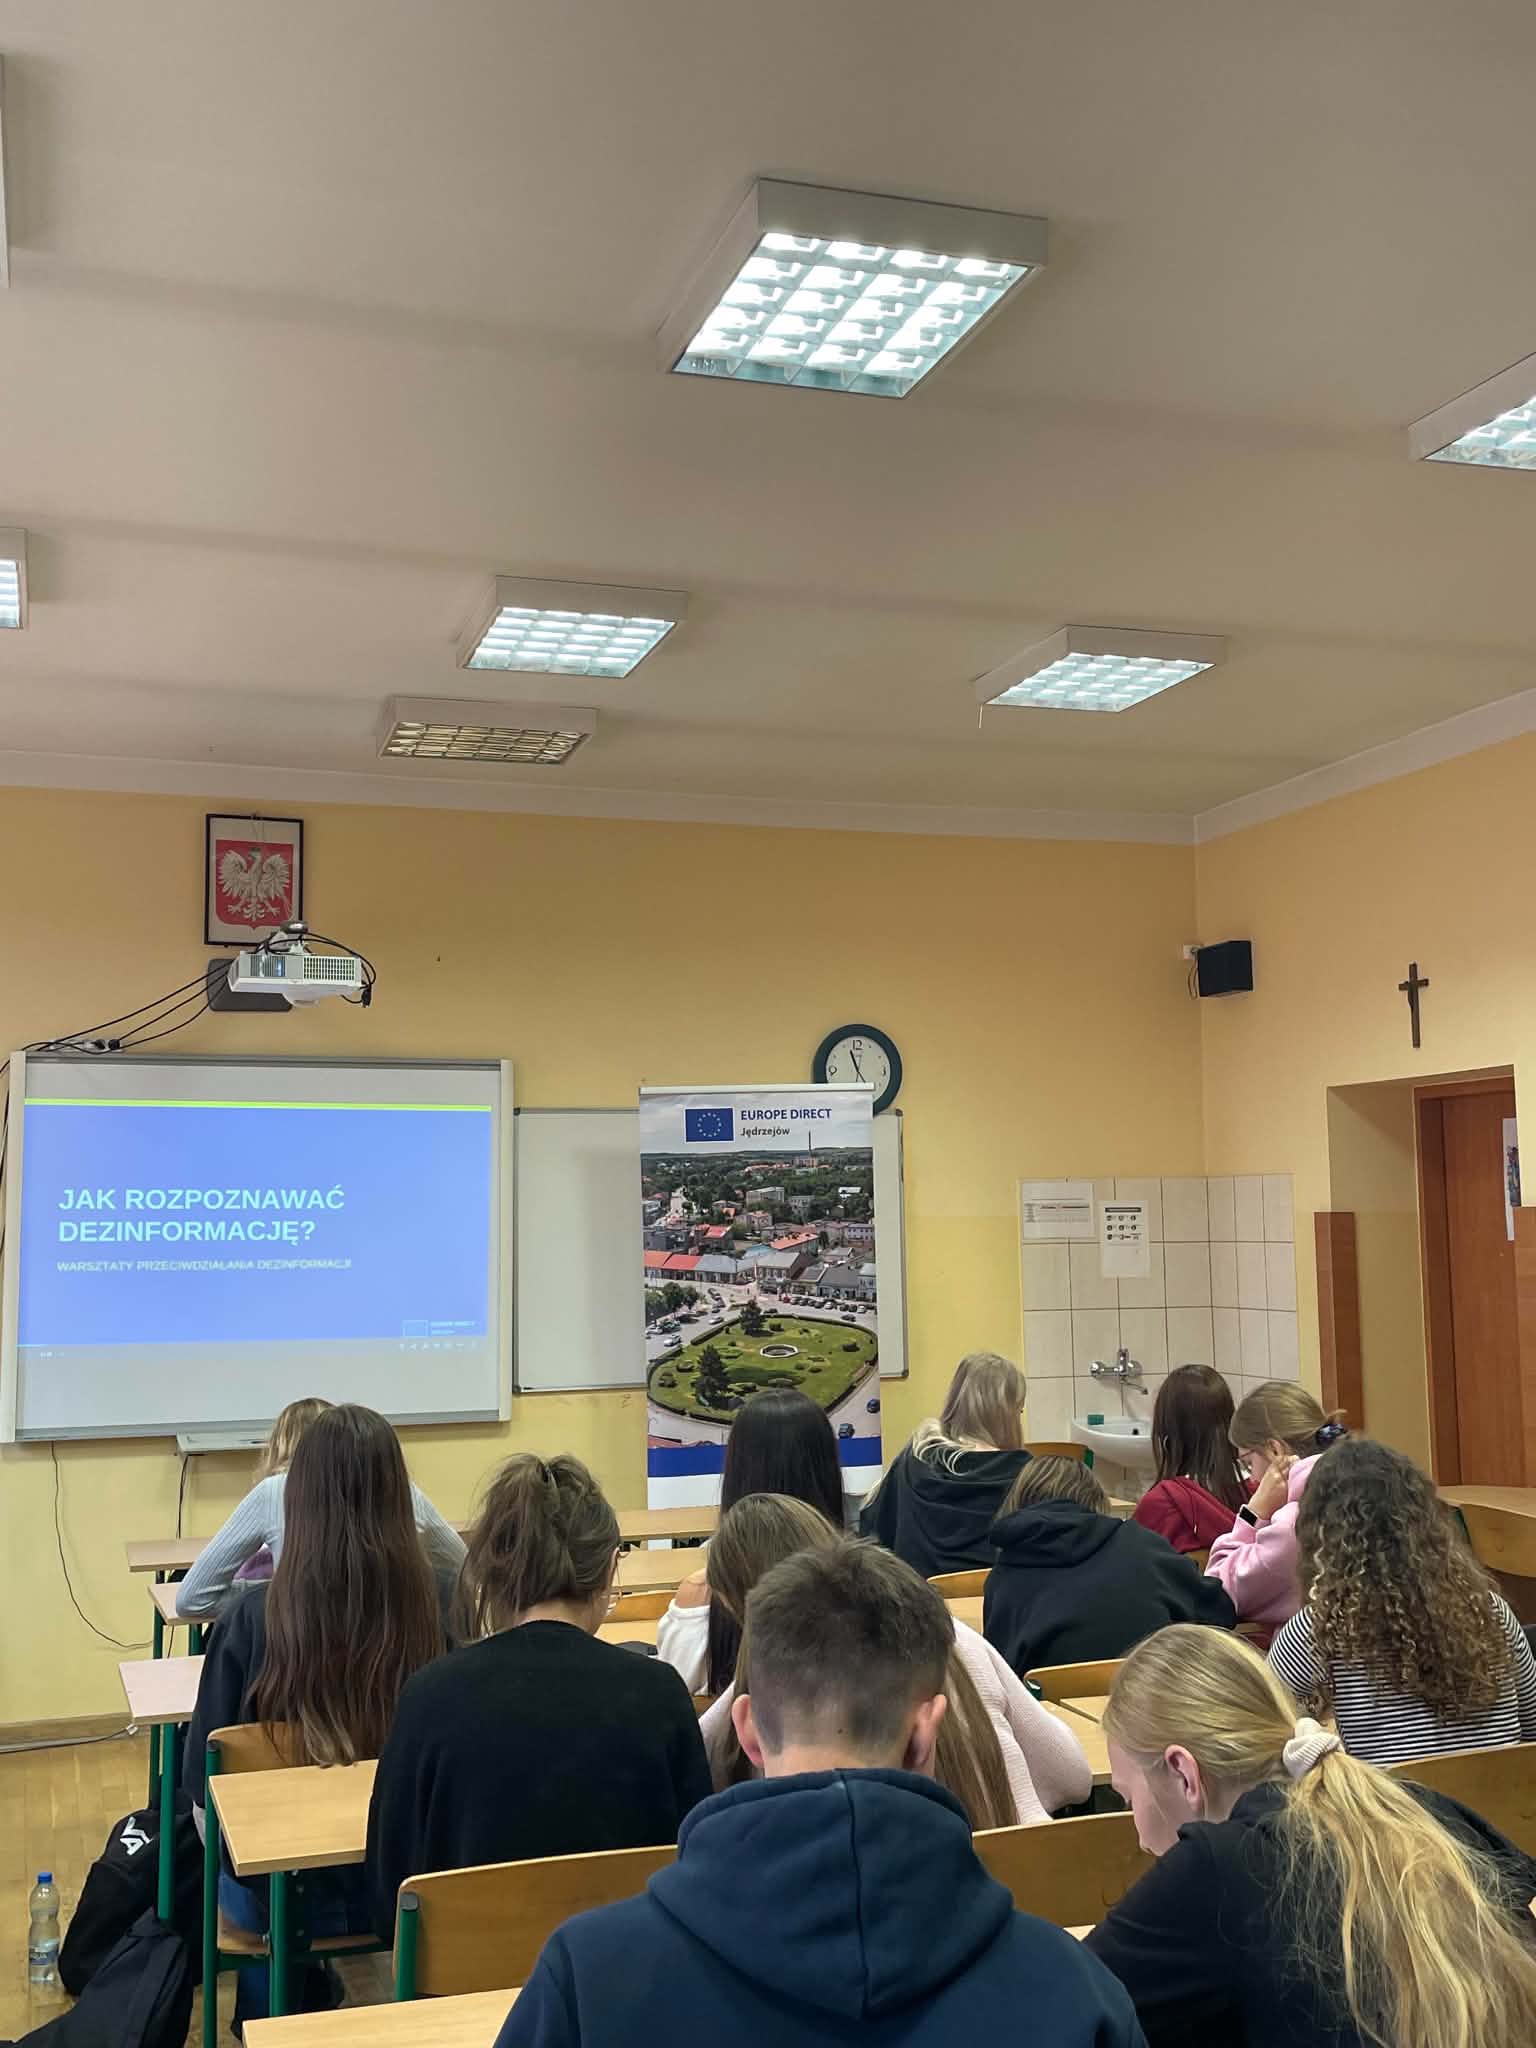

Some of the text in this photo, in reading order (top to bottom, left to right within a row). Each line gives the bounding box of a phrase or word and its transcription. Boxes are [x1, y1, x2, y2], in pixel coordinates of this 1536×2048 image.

[852, 1039, 864, 1051] 12
[740, 1108, 832, 1121] EUROPE DIRECT
[740, 1127, 791, 1138] Jędrzejów
[58, 1184, 345, 1211] JAK ROZPOZNAWAĆ
[58, 1220, 317, 1246] DEZINFORMACJĘ?
[56, 1260, 134, 1273] WARSZTATY
